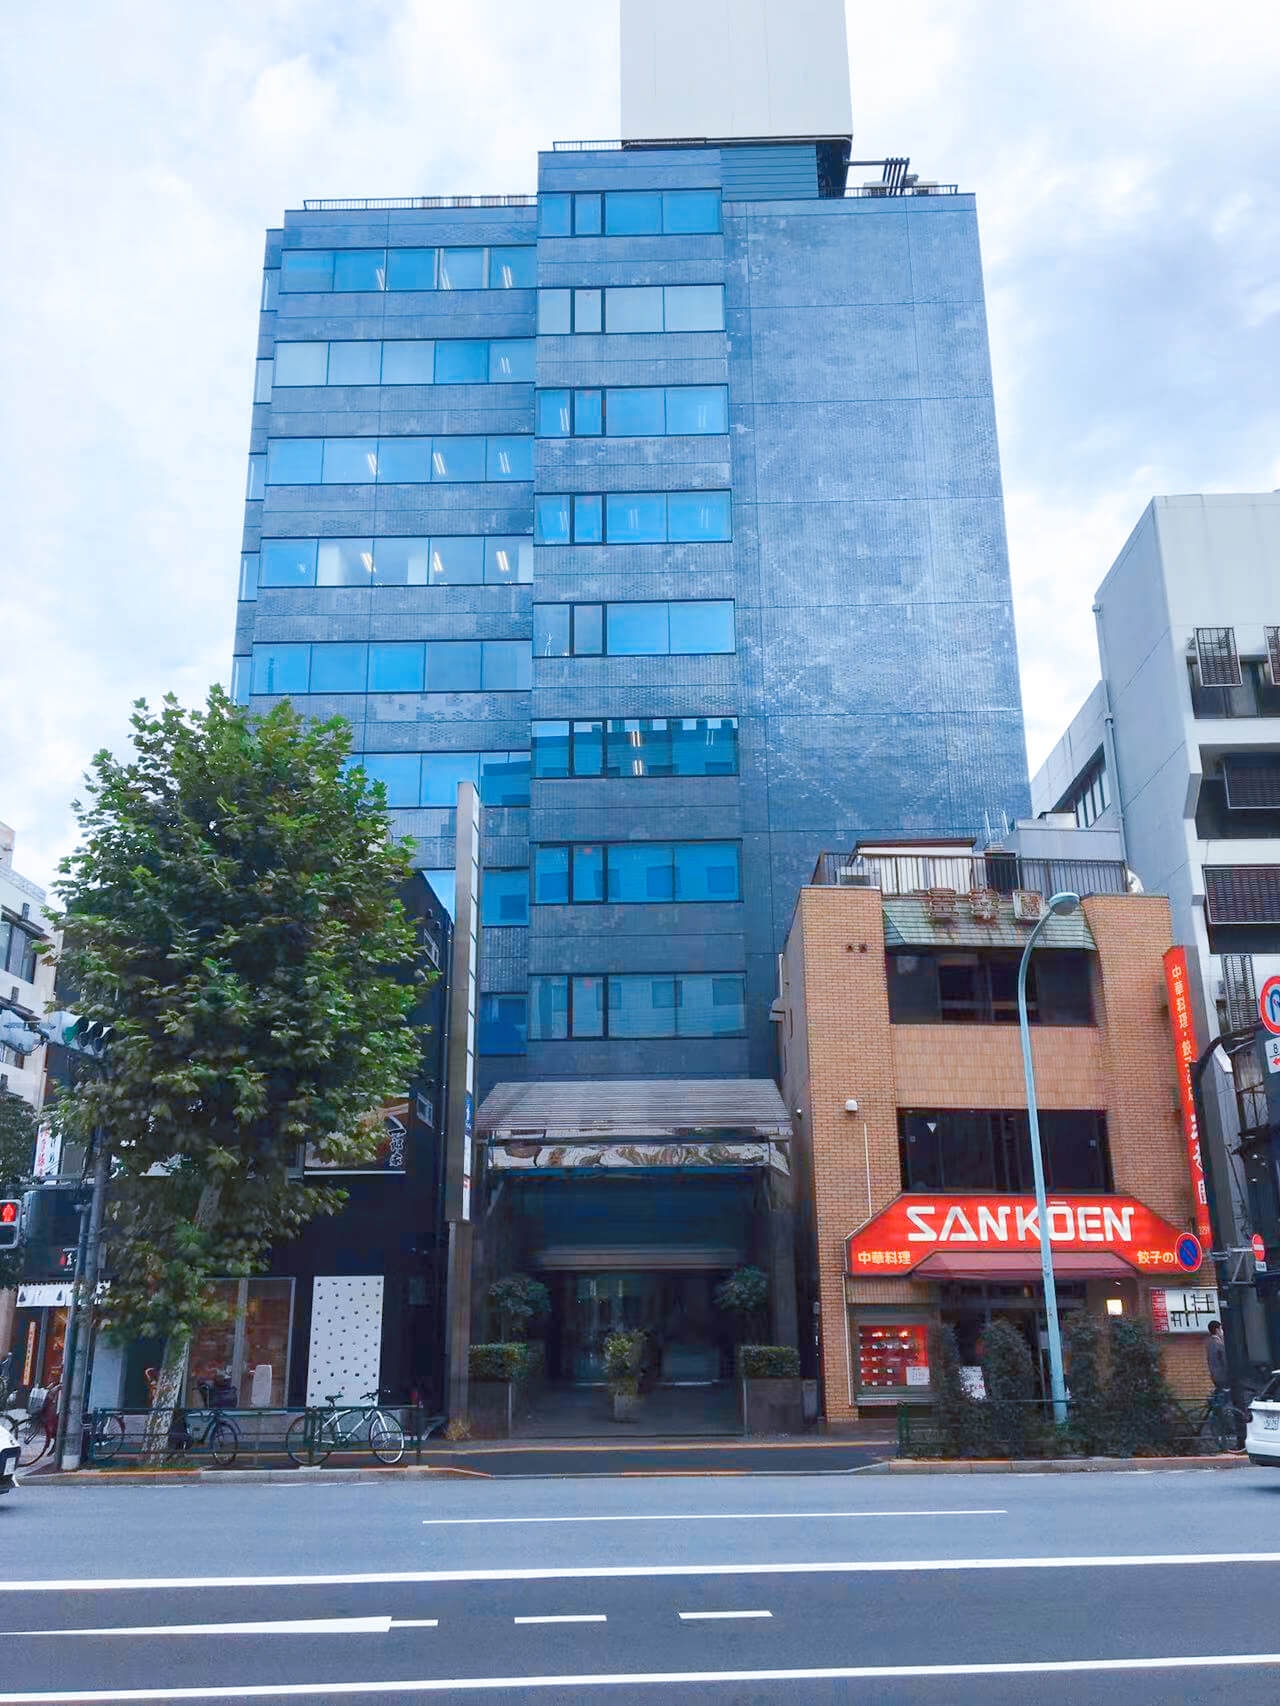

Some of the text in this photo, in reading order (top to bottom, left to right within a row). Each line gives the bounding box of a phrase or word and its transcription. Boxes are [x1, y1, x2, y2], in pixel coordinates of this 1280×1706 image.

[857, 1250, 911, 1265] 中華料理
[1137, 1250, 1177, 1264] 餃子の
